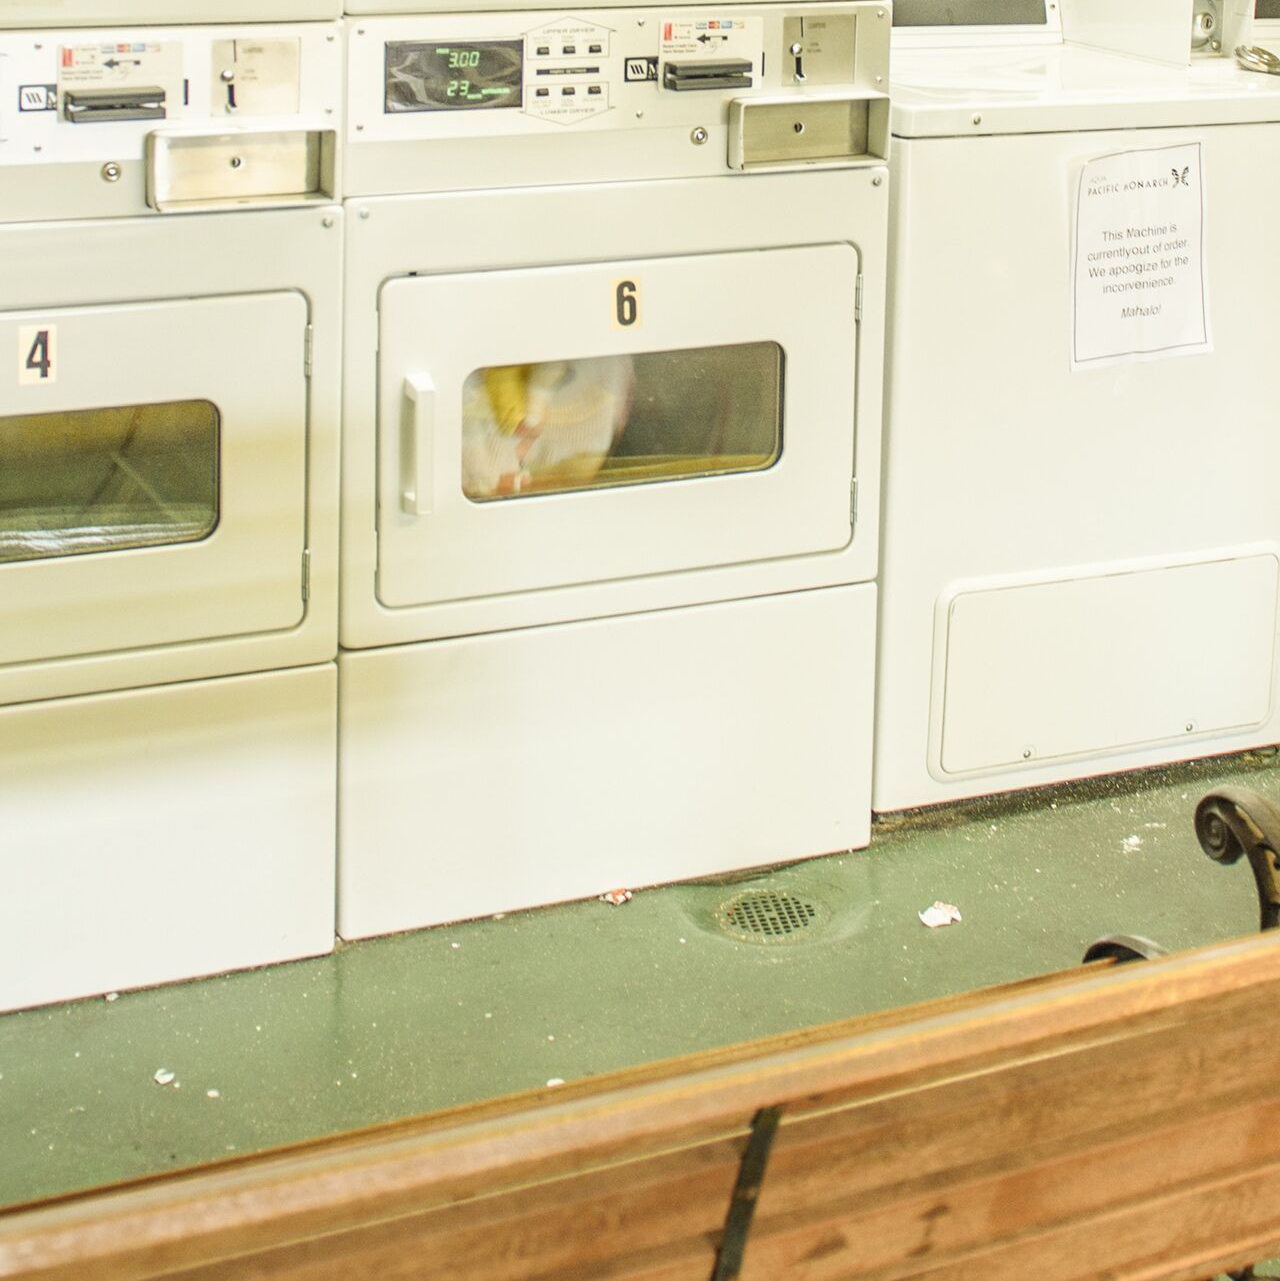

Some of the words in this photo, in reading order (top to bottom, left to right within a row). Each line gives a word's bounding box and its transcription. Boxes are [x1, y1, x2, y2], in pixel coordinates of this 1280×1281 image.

[1087, 183, 1119, 196] PACIFIC
[1102, 231, 1123, 242] This
[1126, 226, 1168, 238] Machine
[1169, 223, 1177, 233] is
[1087, 247, 1132, 262] currently
[1132, 245, 1150, 255] out
[1153, 242, 1162, 253] of
[1088, 267, 1106, 278] We
[1160, 258, 1172, 269] for
[1174, 256, 1189, 266] the
[616, 280, 637, 326] 6
[1121, 304, 1161, 318] Mahalo!
[26, 331, 51, 378] 4
